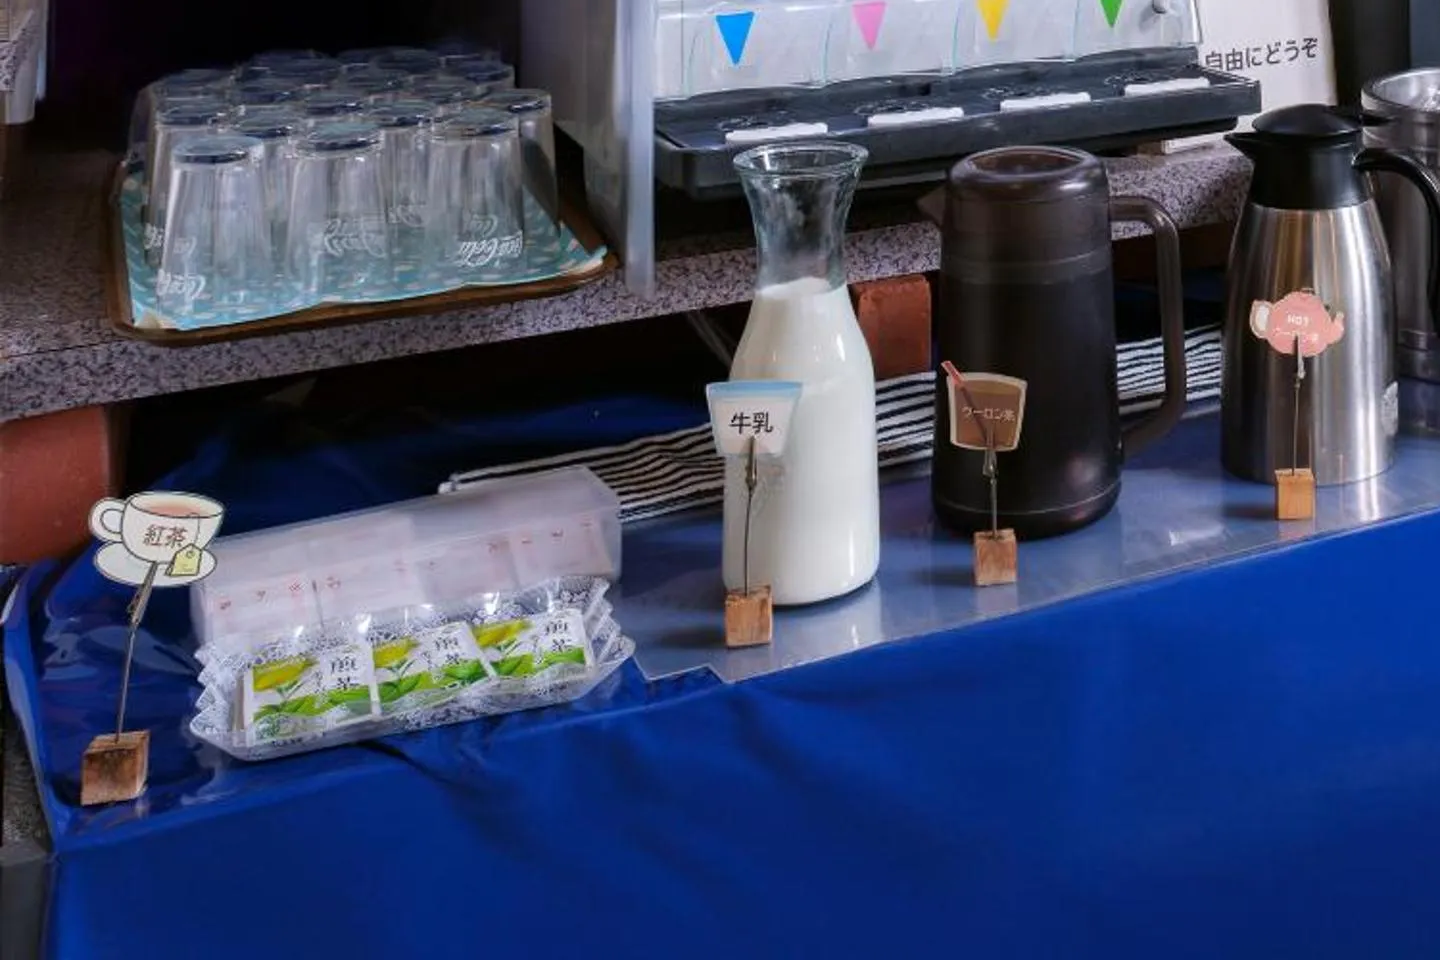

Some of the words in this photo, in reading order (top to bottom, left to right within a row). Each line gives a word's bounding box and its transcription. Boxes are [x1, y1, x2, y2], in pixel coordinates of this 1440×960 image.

[1204, 37, 1319, 71] 自由にどうぞ
[729, 411, 774, 435] 牛乳
[143, 524, 188, 548] 紅茶
